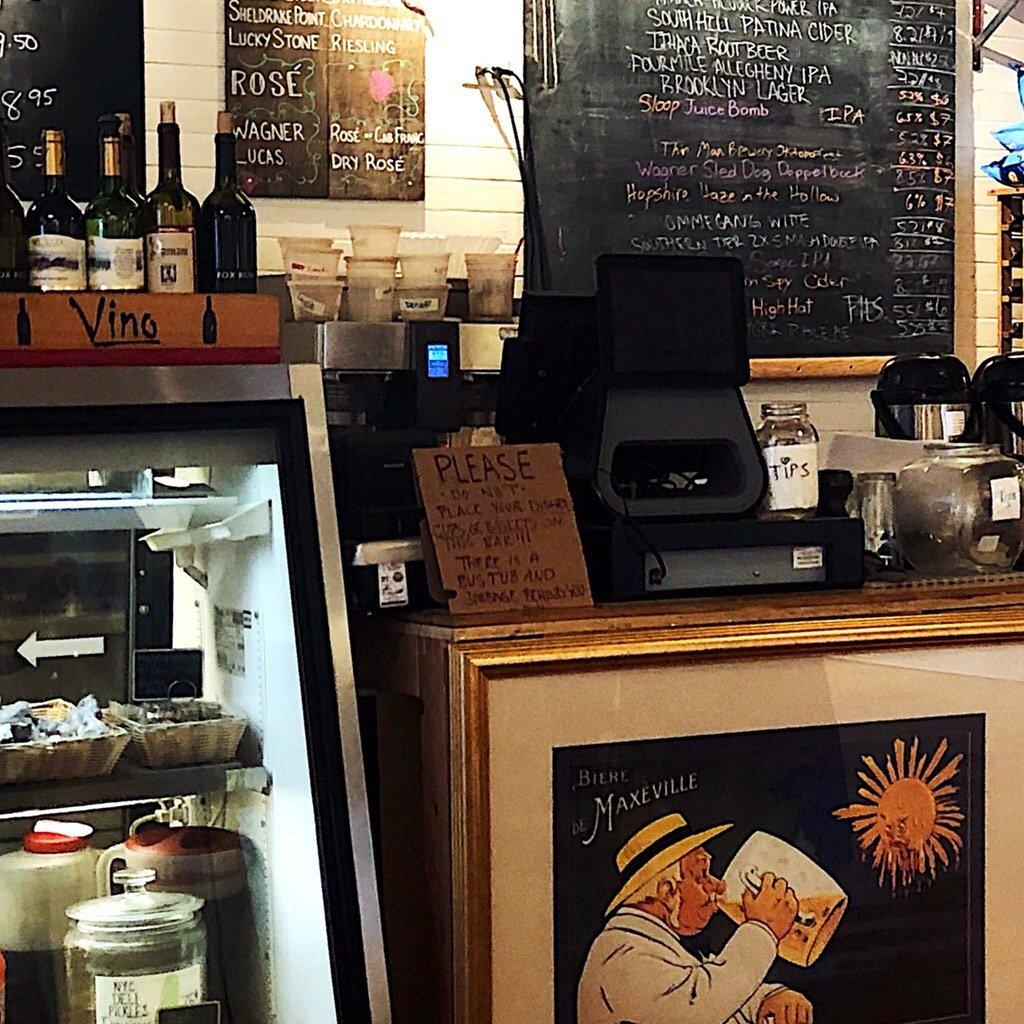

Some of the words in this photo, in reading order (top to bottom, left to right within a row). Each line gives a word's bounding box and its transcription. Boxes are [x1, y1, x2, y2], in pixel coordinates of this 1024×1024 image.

[228, 0, 293, 26] SHELDRAKE
[294, 6, 325, 26] POINT
[647, 8, 693, 31] SOUTH
[696, 11, 736, 35] HILL
[740, 14, 803, 40] PATINA
[808, 21, 857, 45] CIDER
[228, 30, 271, 48] LUCKY
[273, 28, 320, 51] STONE
[330, 35, 396, 55] RIESLING
[645, 31, 701, 57] ITHACA
[231, 64, 303, 98] ROSÉ
[715, 59, 793, 80] ALLEGHENY
[802, 65, 832, 85] IPA
[660, 74, 745, 98] BROOKLYN
[757, 79, 812, 105] LAGER
[637, 94, 680, 119] Sloop
[683, 98, 725, 116] Juice
[727, 100, 769, 118] Bomb
[824, 105, 865, 124] IPA
[233, 123, 305, 142] WAGNER
[332, 154, 358, 172] DRY
[366, 154, 405, 172] ROSÉ
[635, 161, 699, 182] Wagner
[703, 159, 737, 178] Sled
[742, 159, 771, 183] Dog
[69, 296, 158, 342] Vino
[752, 298, 784, 320] High
[787, 298, 813, 315] Hat
[434, 450, 535, 483] PLEASE
